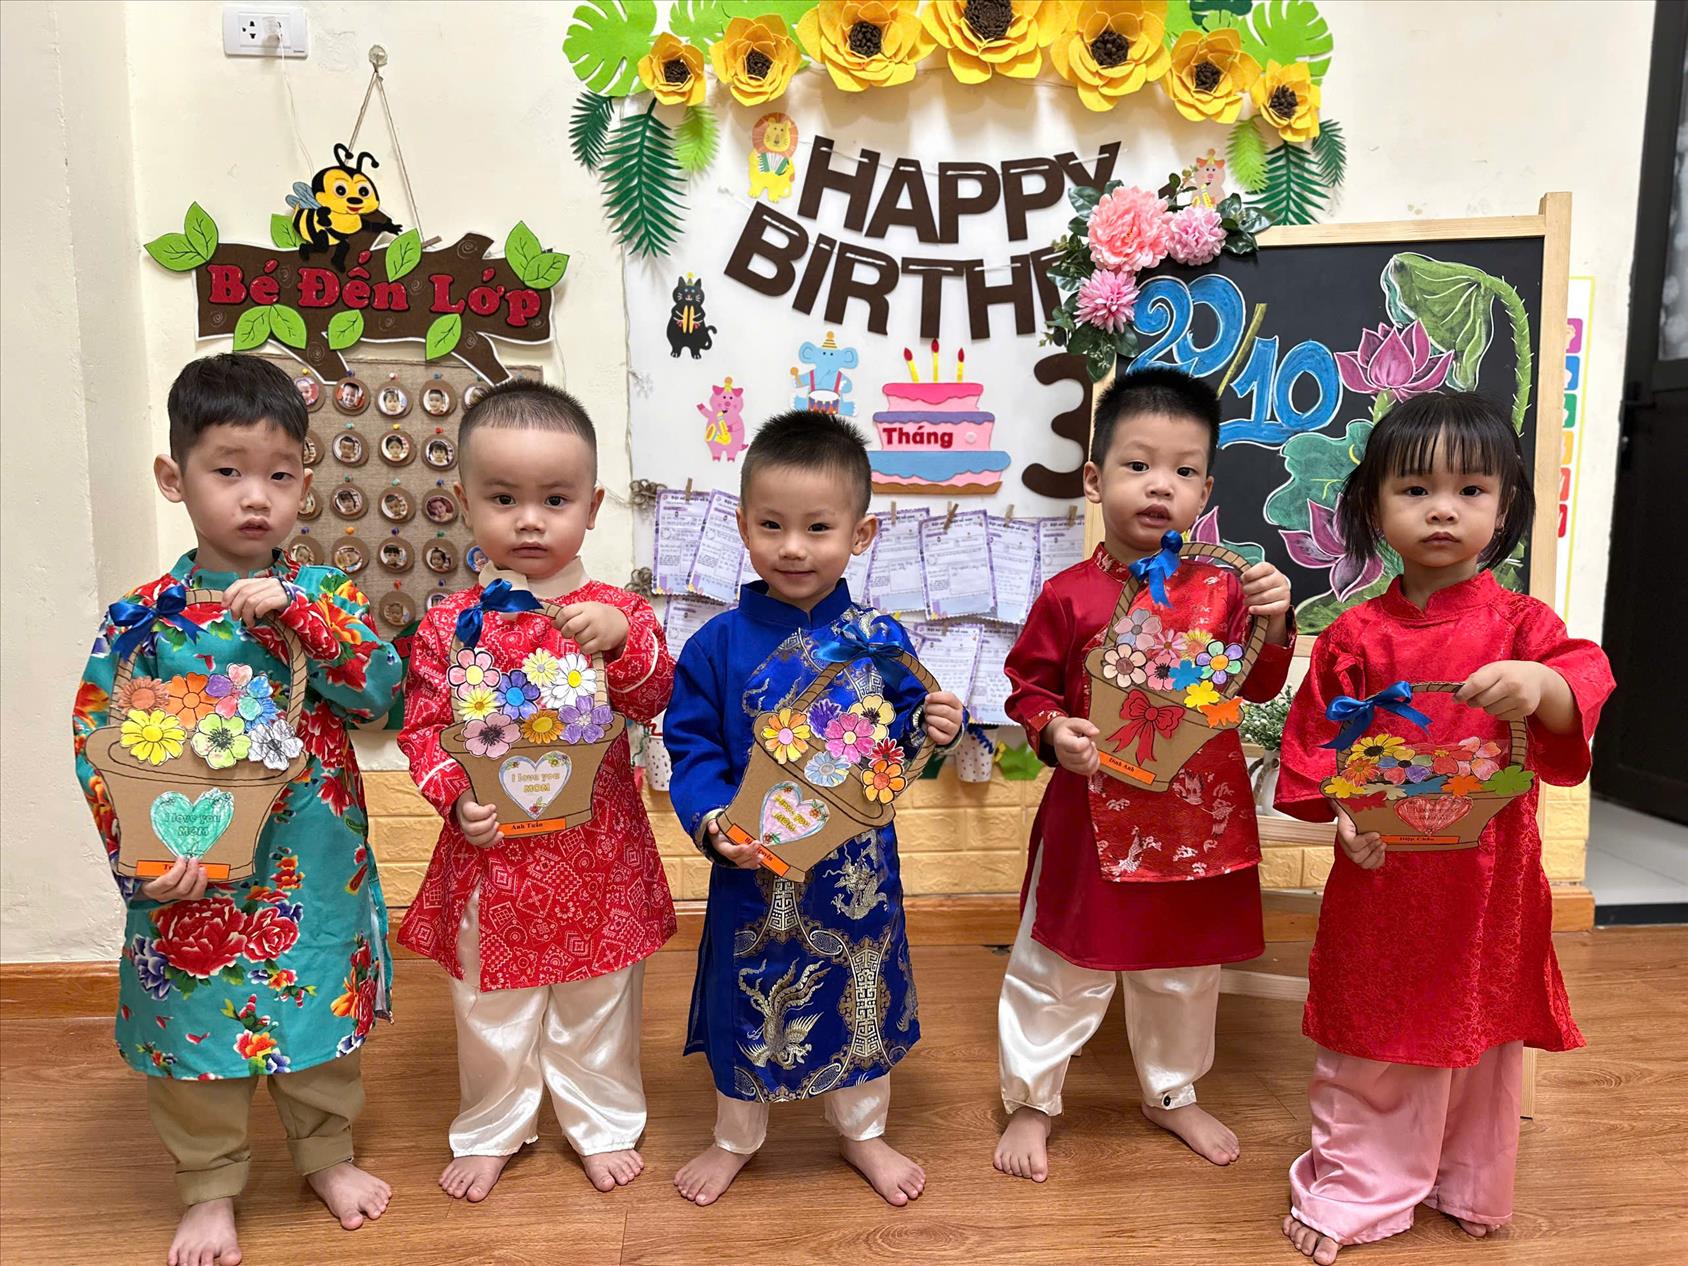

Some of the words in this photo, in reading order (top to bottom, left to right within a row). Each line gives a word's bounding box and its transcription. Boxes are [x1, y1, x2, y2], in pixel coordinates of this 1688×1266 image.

[797, 135, 1122, 244] HAPPY
[206, 259, 280, 306] Bé
[297, 250, 409, 311] Đến
[428, 267, 542, 327] Lớp
[882, 423, 954, 449] Tháng
